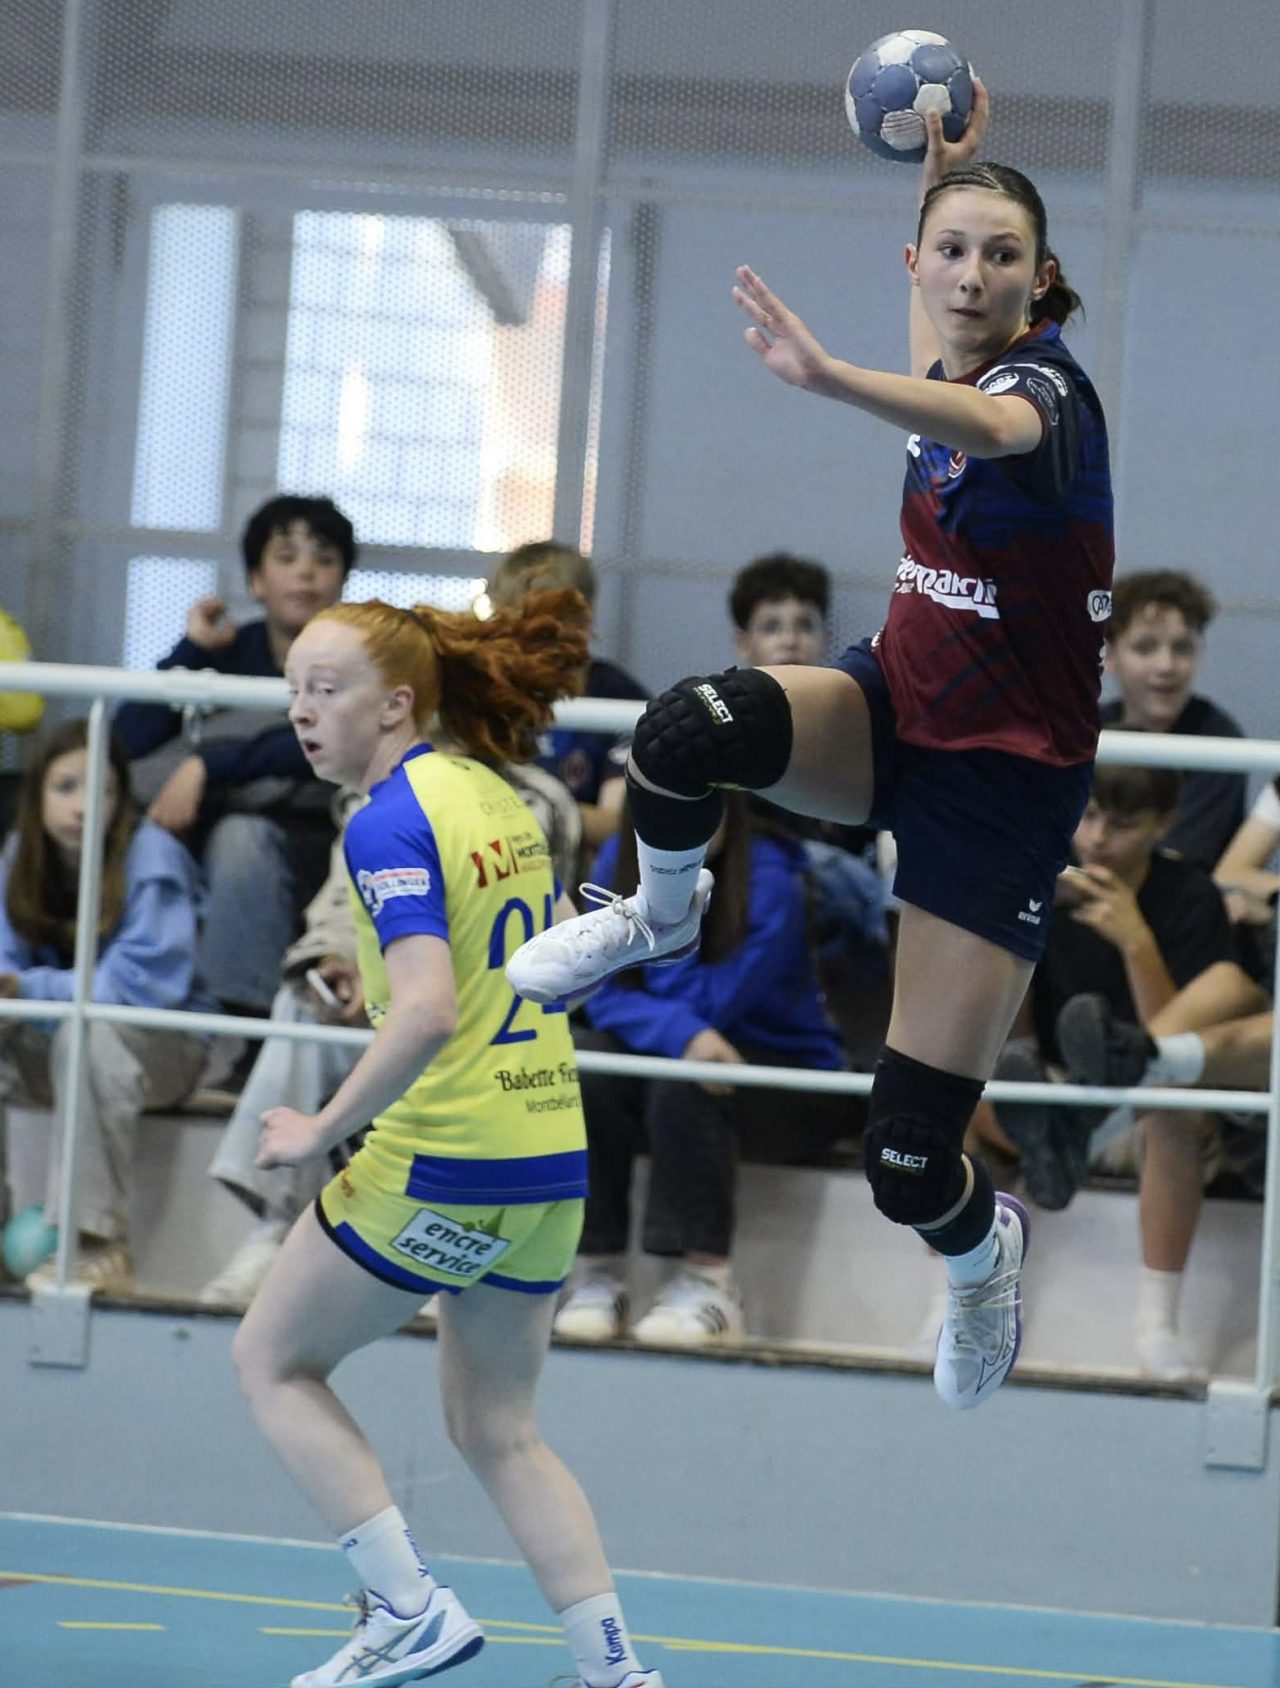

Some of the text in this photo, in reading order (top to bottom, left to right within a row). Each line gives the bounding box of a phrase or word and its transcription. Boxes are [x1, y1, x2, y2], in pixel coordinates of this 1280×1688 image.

[698, 683, 734, 724] SELECT
[494, 1067, 556, 1092] Babette
[880, 1148, 928, 1169] SELECT
[399, 1237, 482, 1274] service
[424, 1222, 492, 1256] encre
